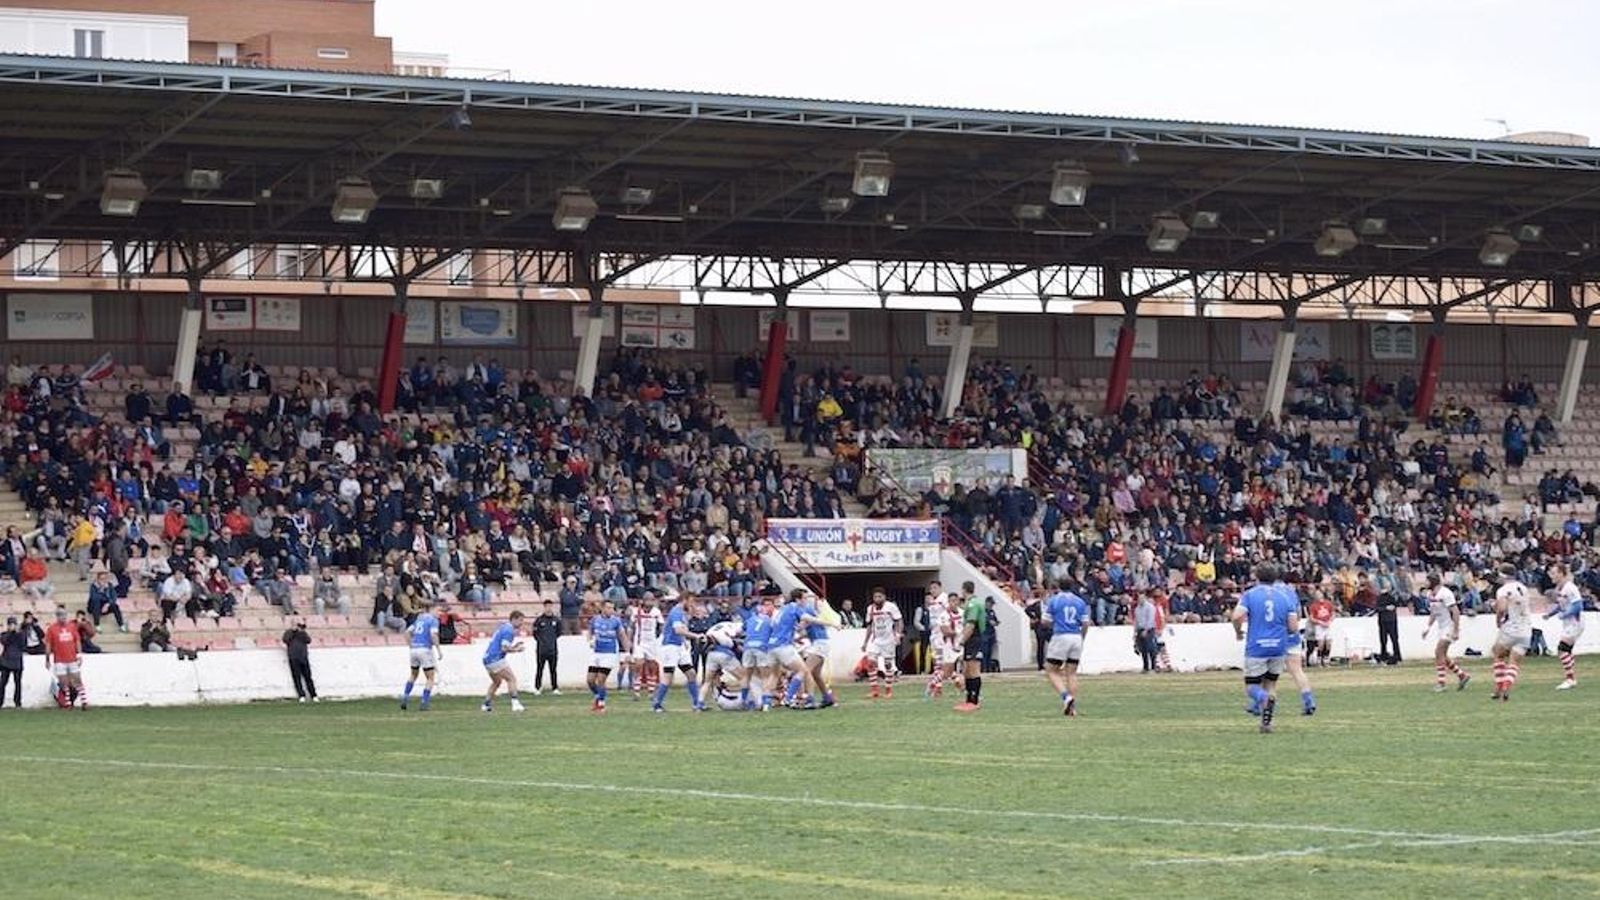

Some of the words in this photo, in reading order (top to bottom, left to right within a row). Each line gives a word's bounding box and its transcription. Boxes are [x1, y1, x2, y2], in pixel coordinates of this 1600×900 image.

[806, 525, 842, 542] UNIÓN
[866, 529, 903, 542] RUGBY
[825, 550, 885, 563] ALMERÍA
[1063, 606, 1077, 624] 12
[1264, 600, 1275, 622] 3
[754, 618, 764, 632] 7
